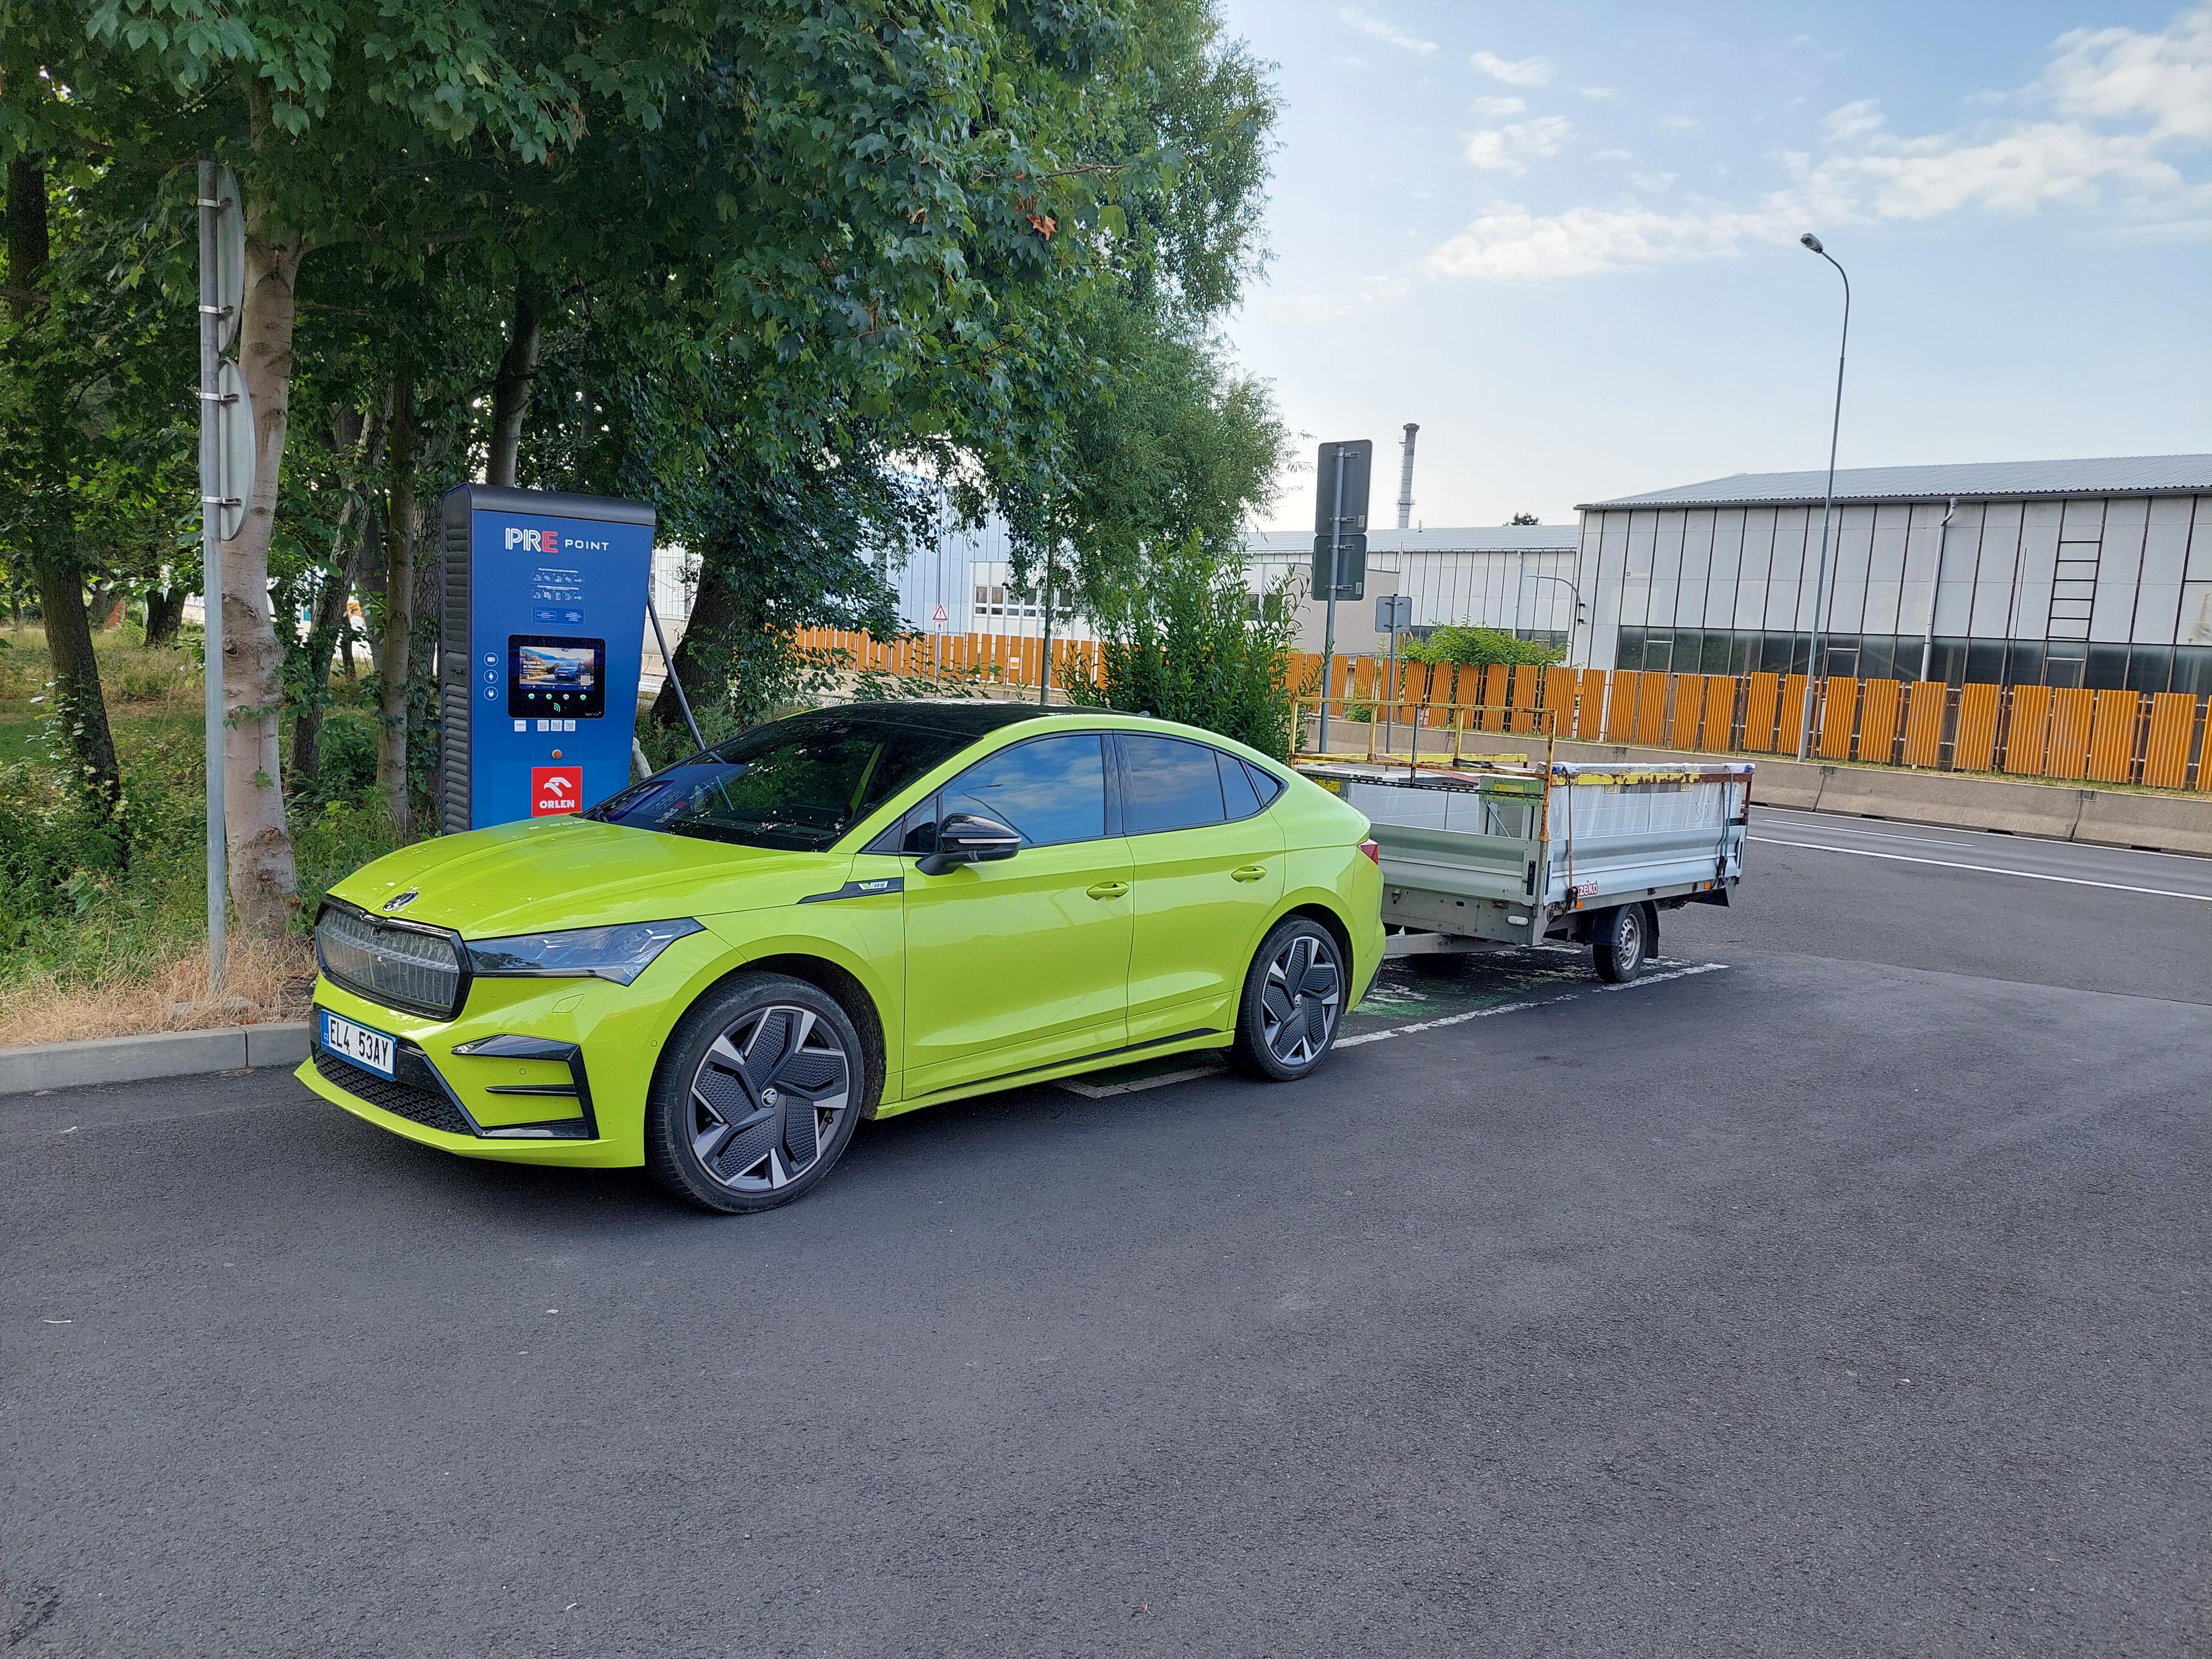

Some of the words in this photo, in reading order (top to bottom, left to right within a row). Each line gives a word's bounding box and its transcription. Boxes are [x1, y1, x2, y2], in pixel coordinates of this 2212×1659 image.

[505, 528, 558, 554] PRE
[565, 539, 609, 551] POINT
[539, 800, 575, 809] ORLEN
[331, 1019, 350, 1055] EL4
[359, 1031, 388, 1067] 53AY
